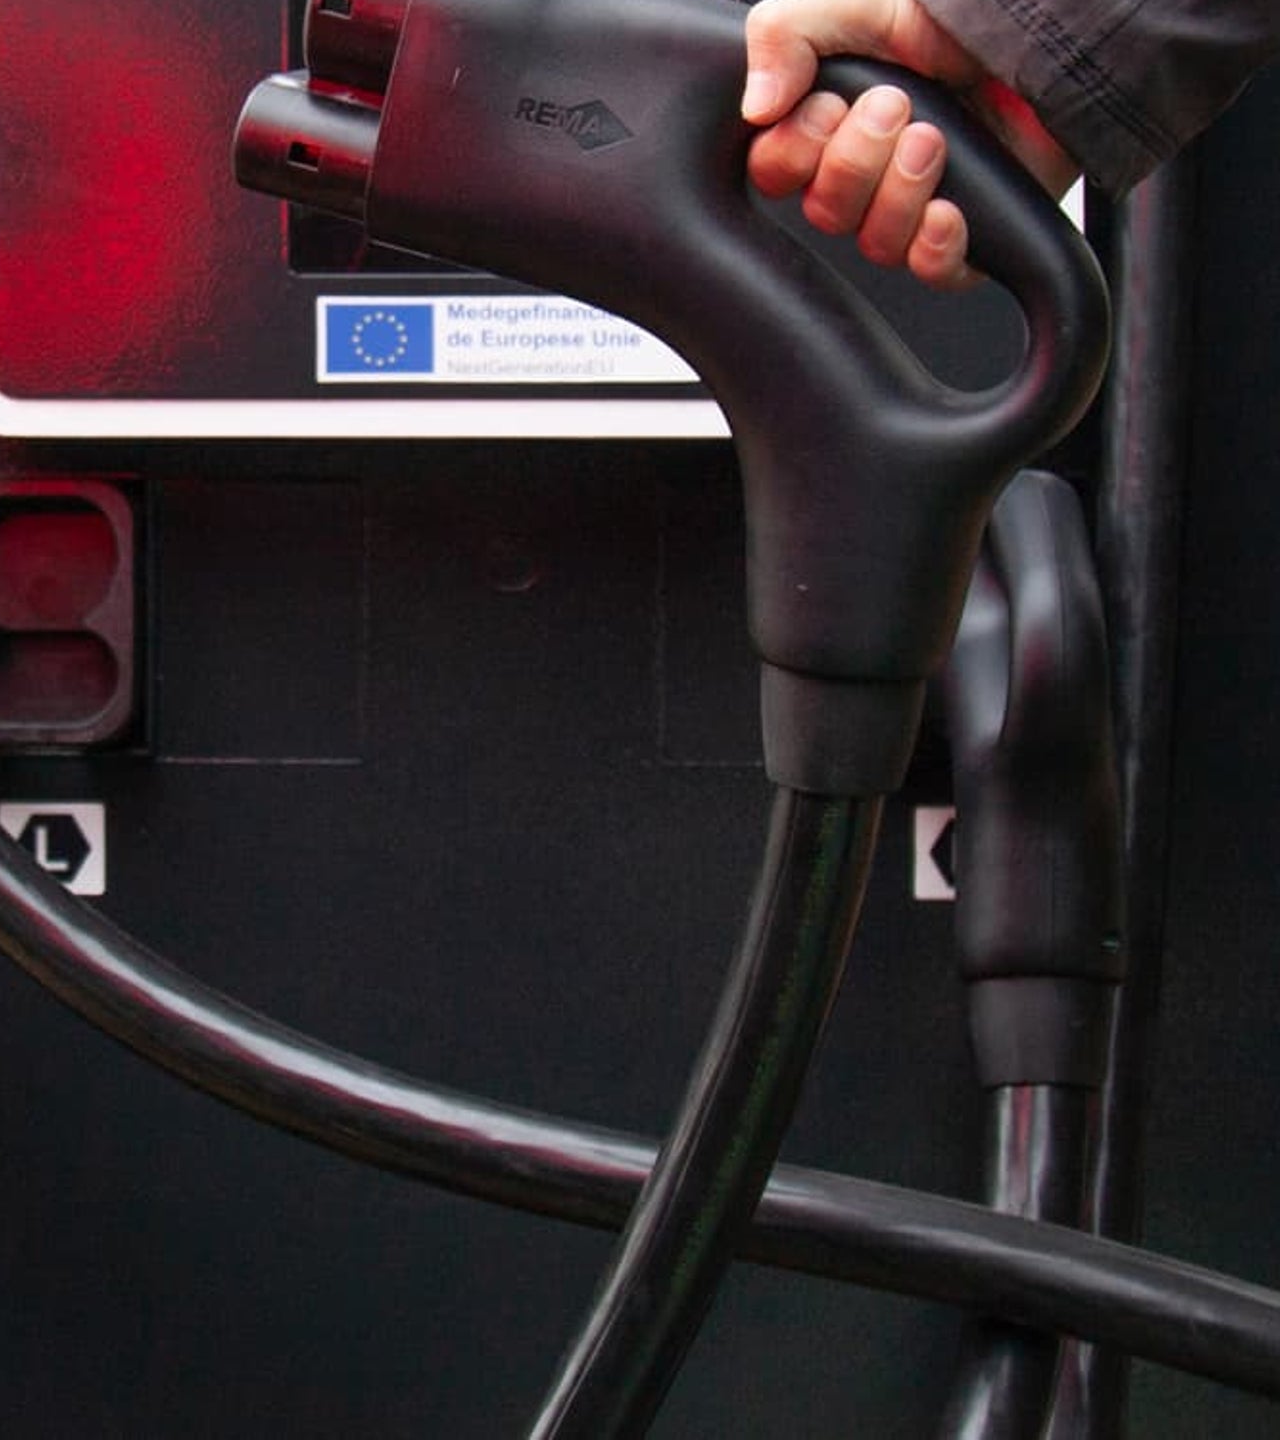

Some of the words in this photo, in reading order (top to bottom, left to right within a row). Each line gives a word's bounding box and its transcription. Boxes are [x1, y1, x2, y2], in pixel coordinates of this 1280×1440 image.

[515, 98, 602, 138] REMA
[447, 303, 611, 324] Medegefinanci
[447, 329, 473, 348] de
[480, 329, 585, 350] Europese
[592, 329, 642, 348] Unie
[36, 825, 68, 872] L
